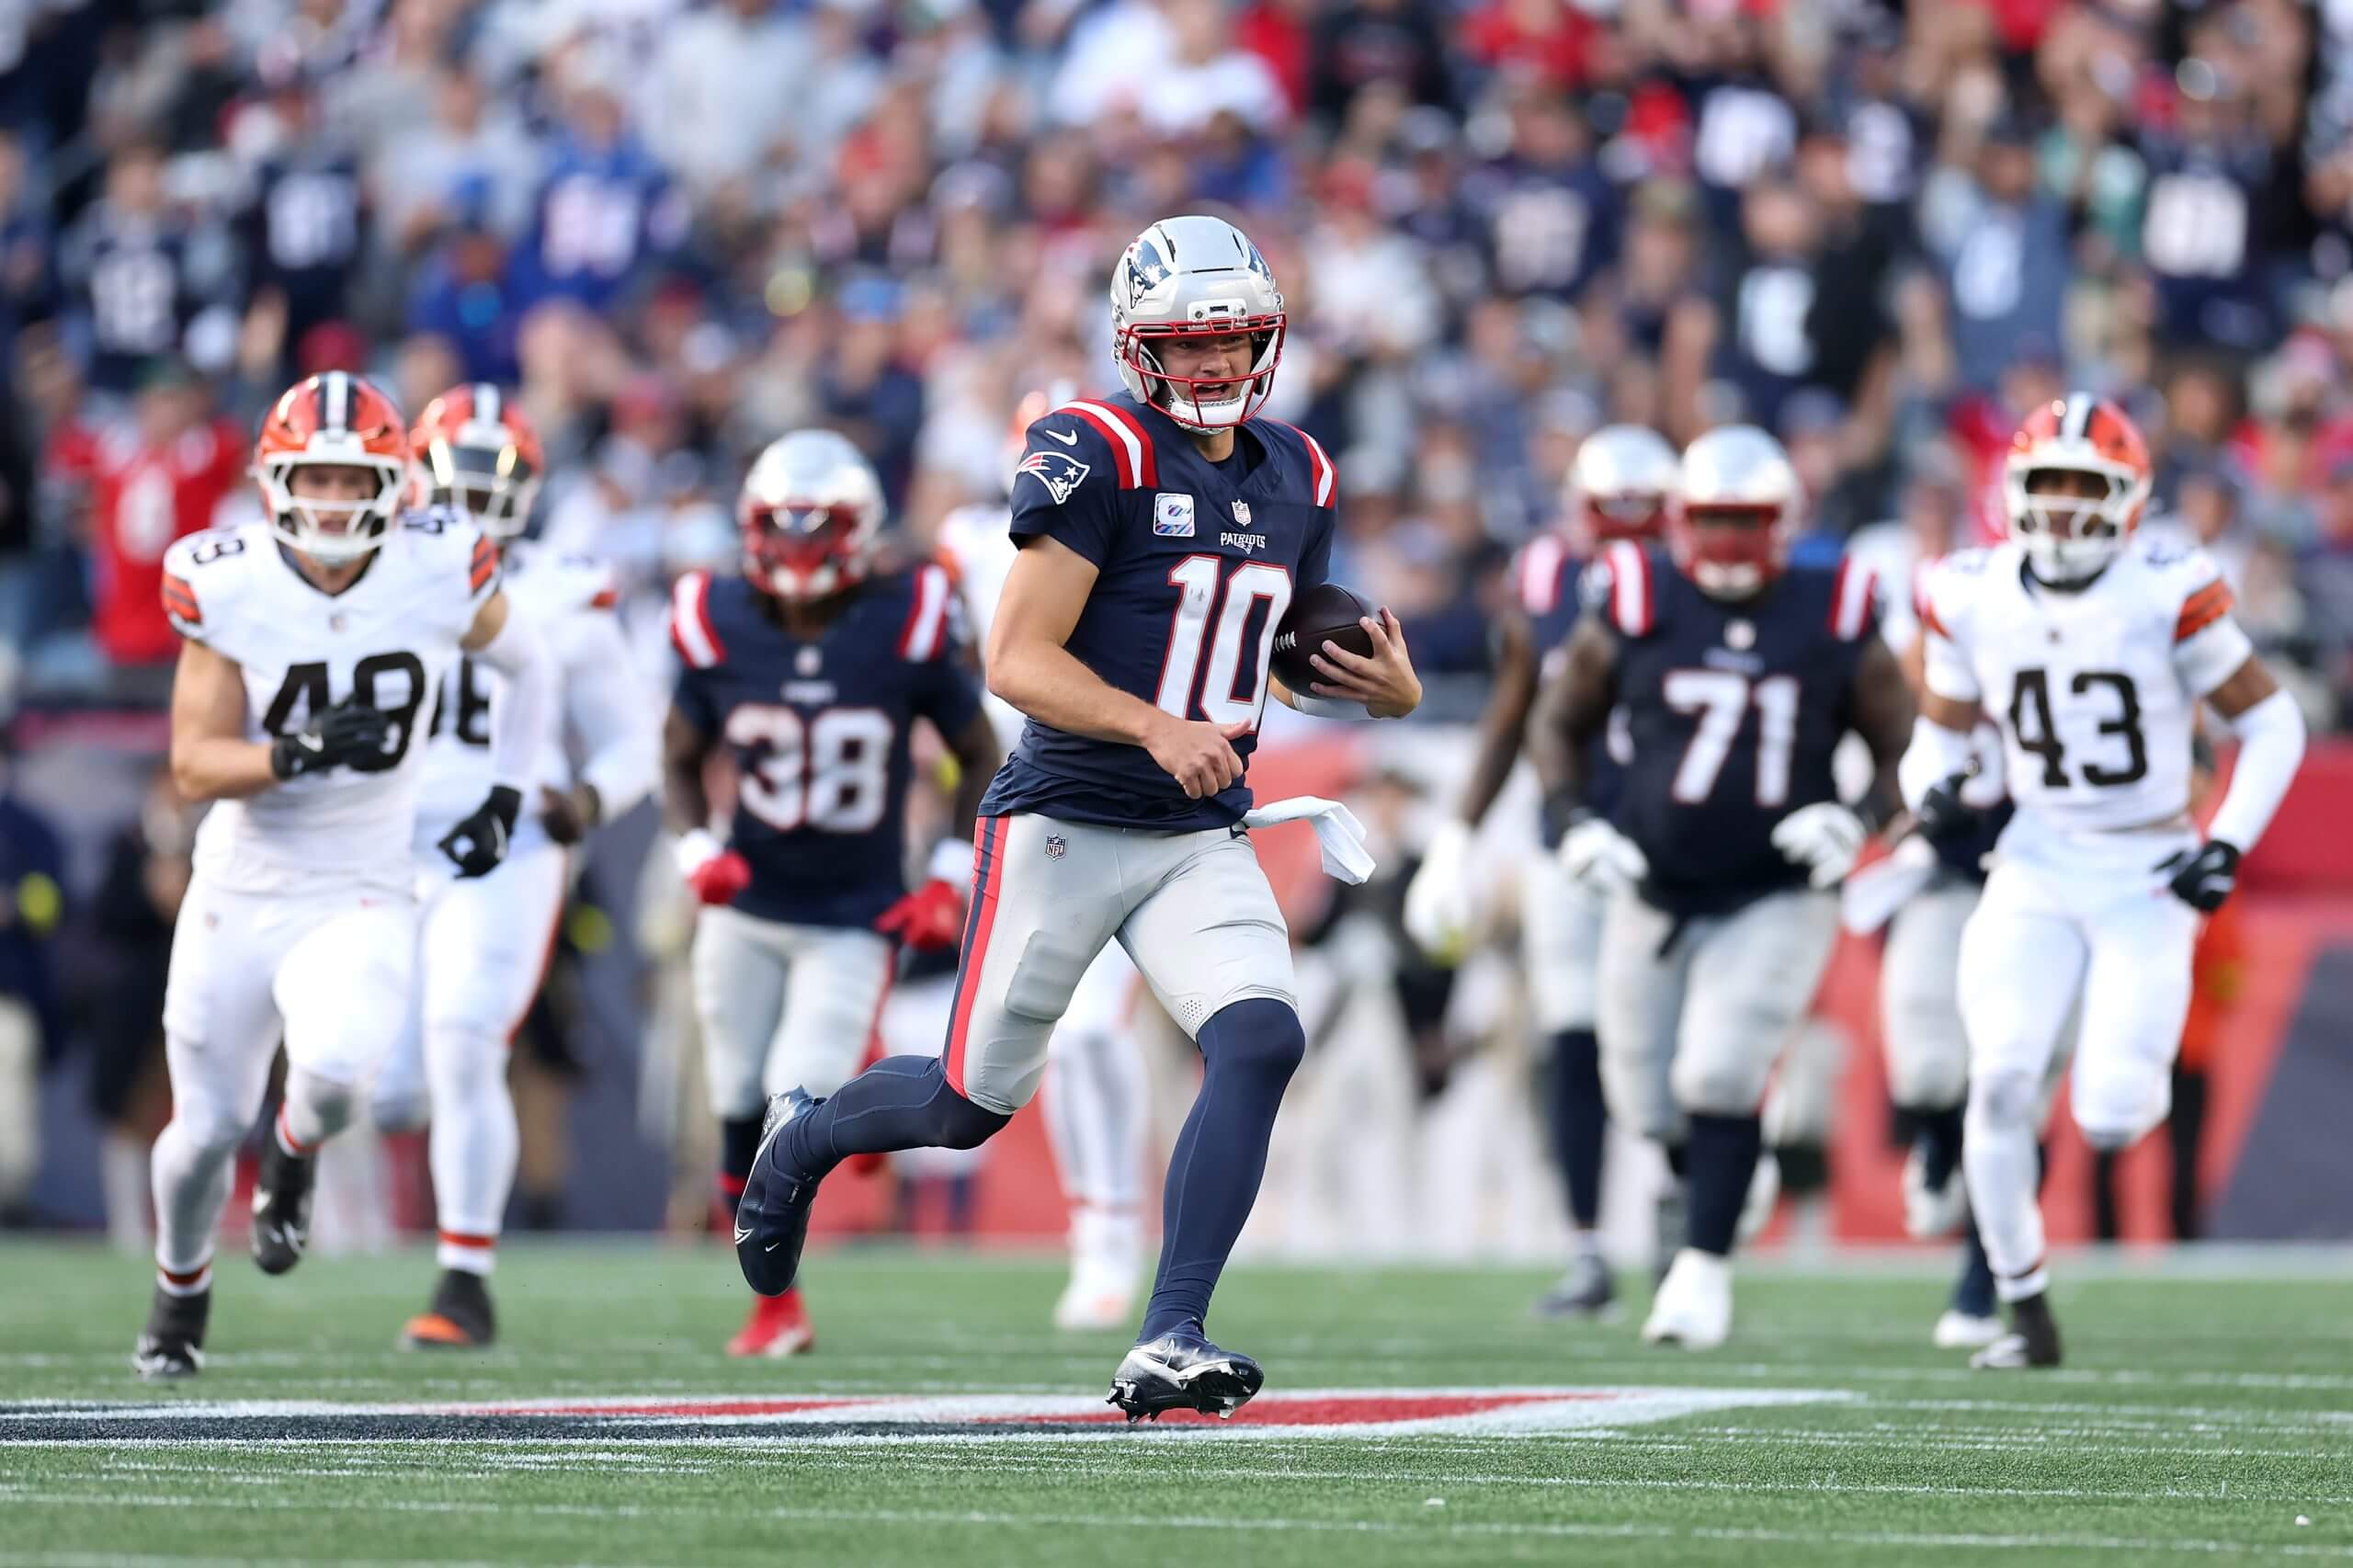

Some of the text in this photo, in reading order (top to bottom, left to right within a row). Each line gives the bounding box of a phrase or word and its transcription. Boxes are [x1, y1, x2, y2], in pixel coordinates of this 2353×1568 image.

[1157, 496, 1193, 527] C
[1221, 532, 1266, 549] PATRIOTS
[1154, 553, 1293, 735] 10
[262, 651, 425, 772] 49
[725, 702, 895, 832] 38
[1662, 669, 1800, 808] 71
[2008, 665, 2148, 789] 43
